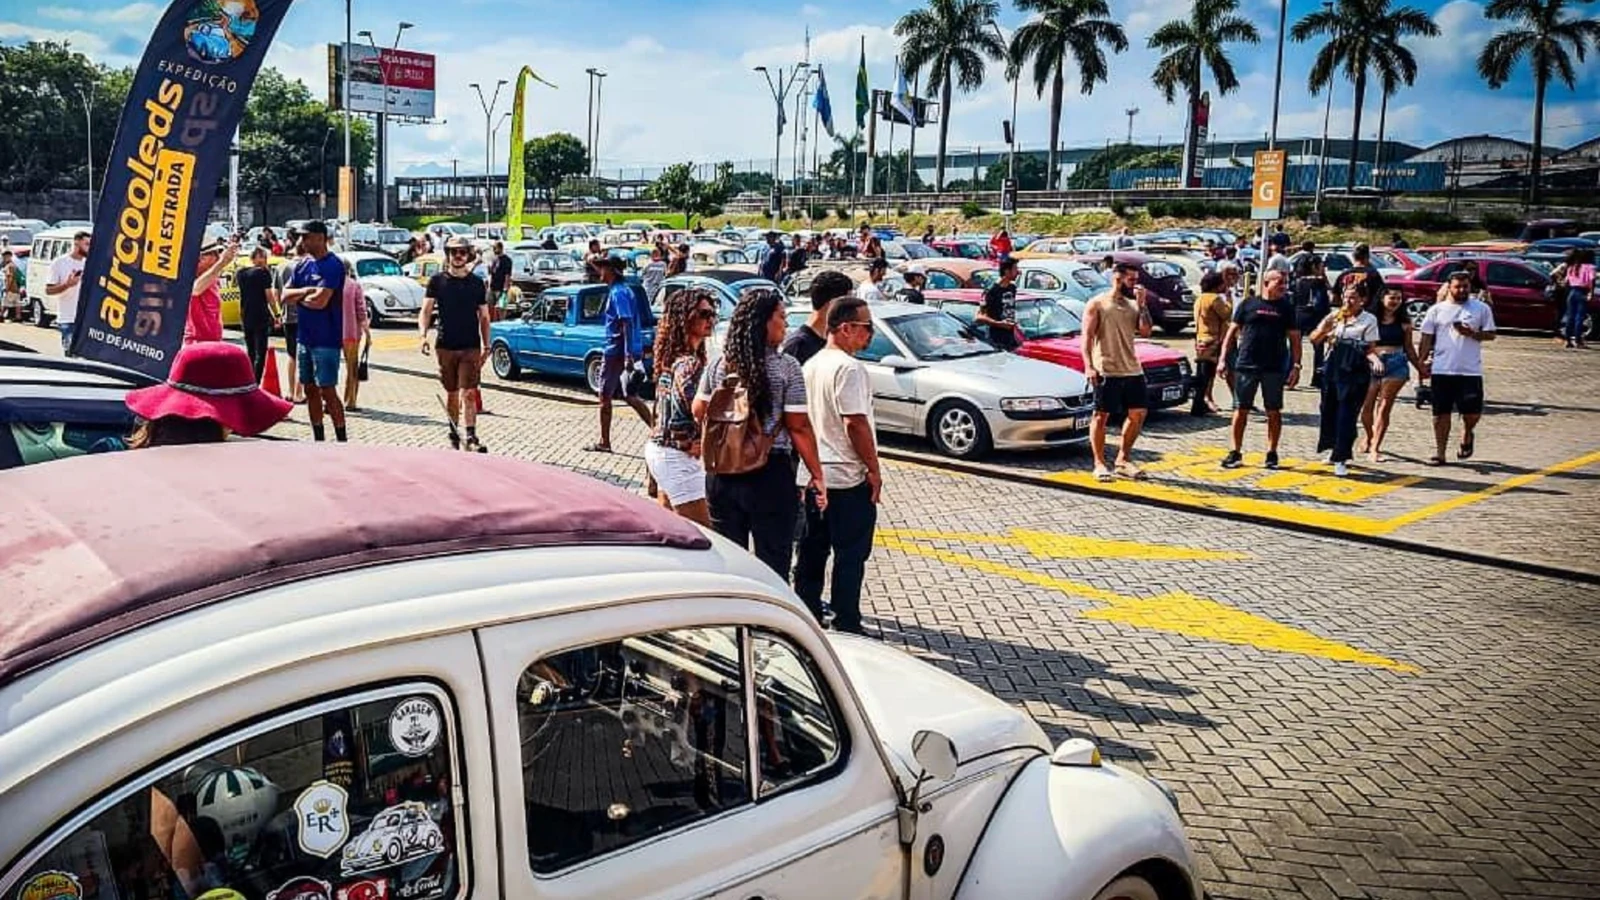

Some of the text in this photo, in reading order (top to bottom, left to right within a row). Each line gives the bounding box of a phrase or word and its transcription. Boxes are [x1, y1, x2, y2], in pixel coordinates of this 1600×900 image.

[158, 60, 237, 93] EXPEDIÇÃO
[99, 78, 184, 330] aircooleds
[1259, 181, 1274, 201] G
[157, 161, 185, 271] NA ESTRADA
[88, 327, 164, 361] RIO DE JANEIRO
